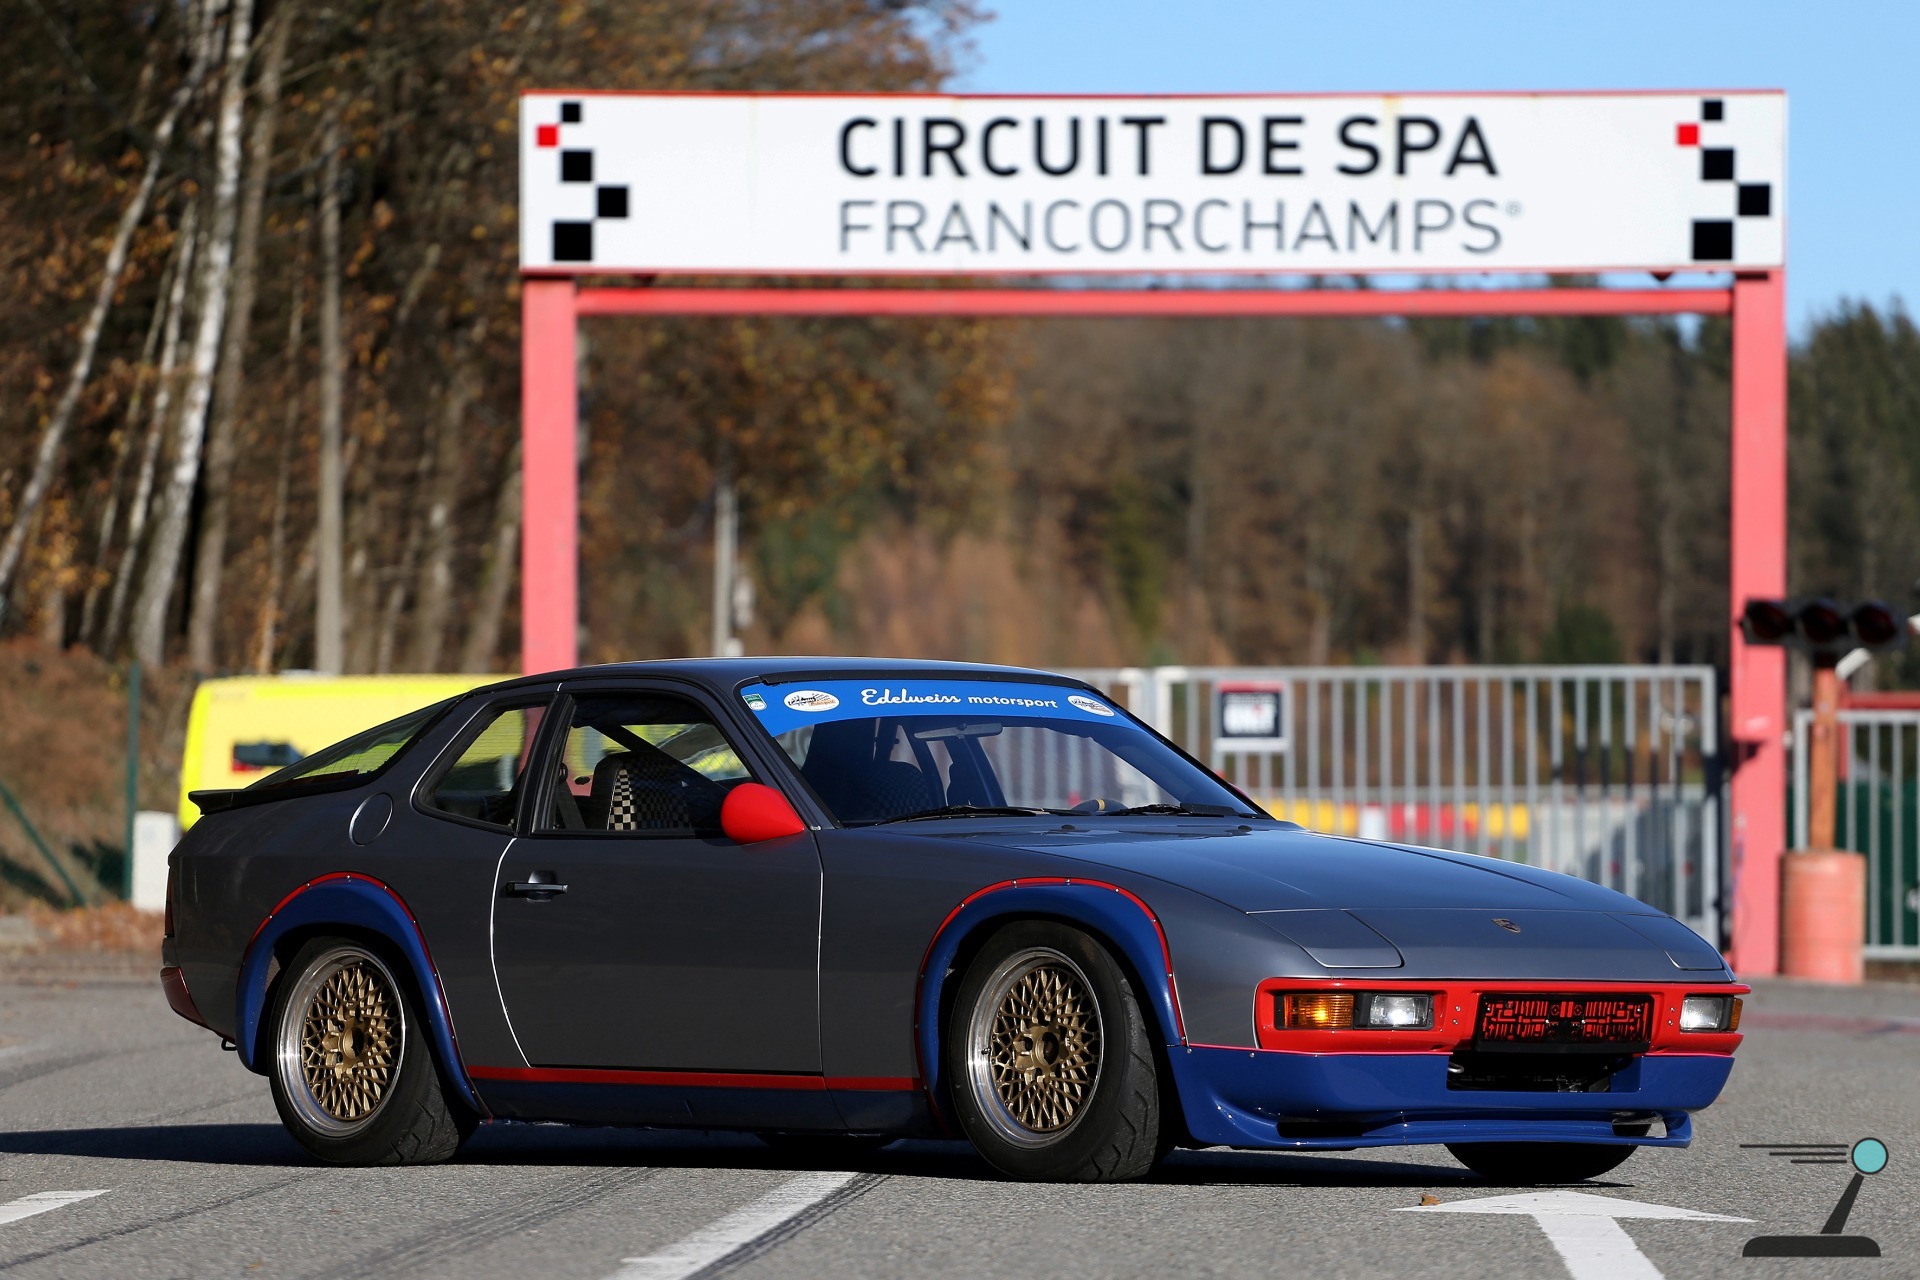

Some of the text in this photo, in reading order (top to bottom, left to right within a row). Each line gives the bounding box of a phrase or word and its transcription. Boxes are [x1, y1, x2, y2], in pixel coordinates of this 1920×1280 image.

[838, 114, 1500, 178] CIRCUIT DE SPA
[838, 197, 1503, 254] FRANCORCHAMPS
[860, 688, 962, 706] Edelweiss
[966, 695, 1059, 708] motorsport
